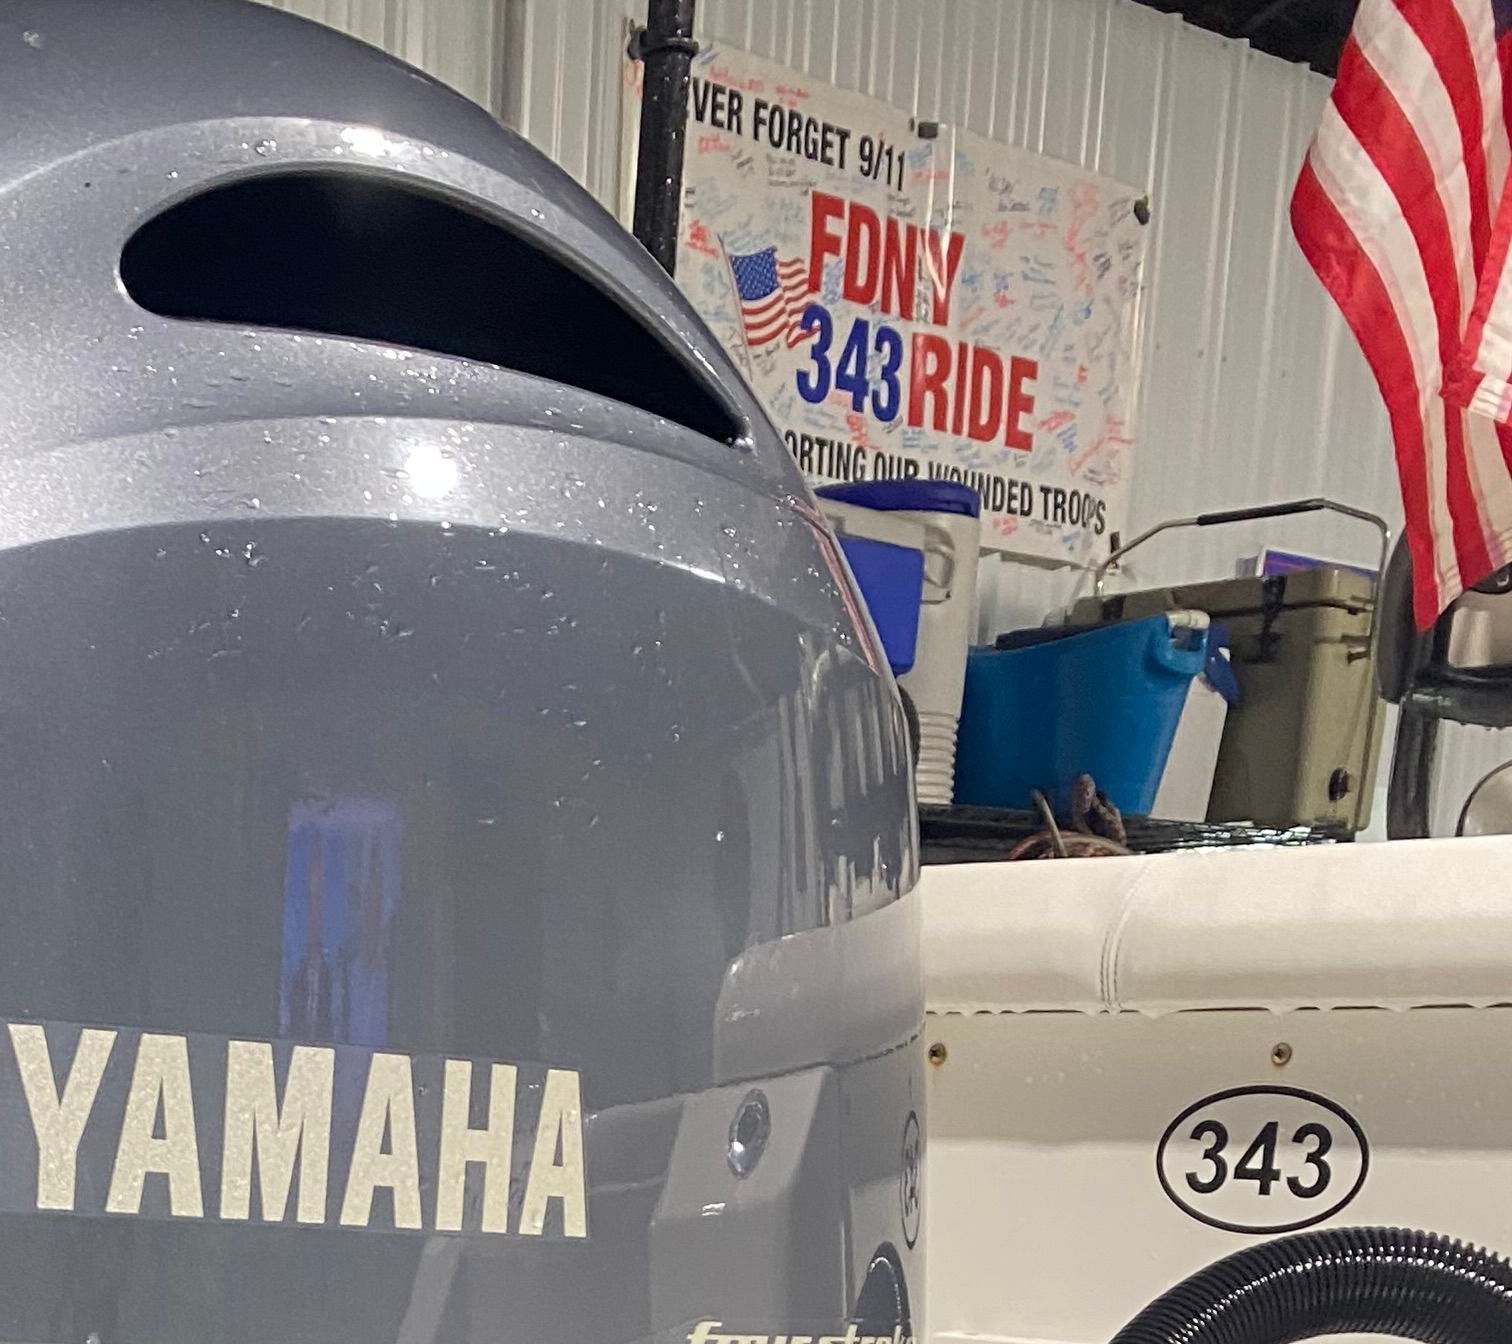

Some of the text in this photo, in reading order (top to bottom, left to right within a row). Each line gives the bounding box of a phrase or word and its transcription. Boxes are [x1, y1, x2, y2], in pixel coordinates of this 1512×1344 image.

[691, 76, 743, 135] VER
[753, 98, 851, 169] FORGET
[859, 135, 905, 191] 9/11
[808, 190, 965, 327] FDNY
[796, 304, 1038, 452] 343 RIDE
[1040, 485, 1106, 535] TROOPS
[7, 1023, 588, 1239] YAMAHA
[1185, 1119, 1333, 1199] 343
